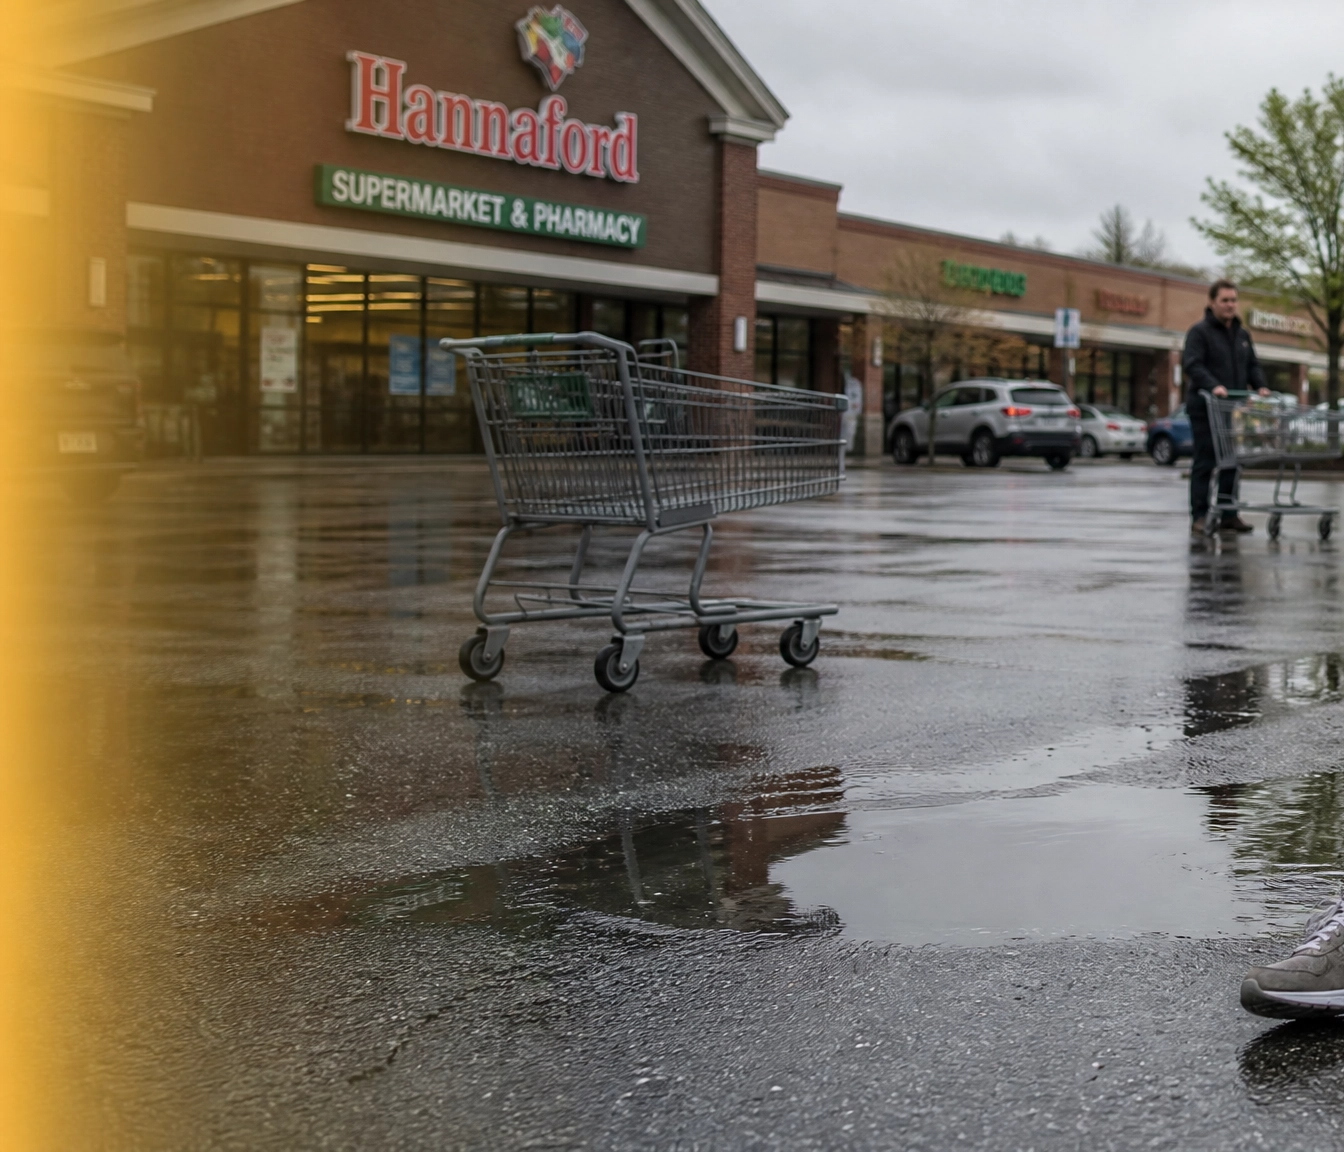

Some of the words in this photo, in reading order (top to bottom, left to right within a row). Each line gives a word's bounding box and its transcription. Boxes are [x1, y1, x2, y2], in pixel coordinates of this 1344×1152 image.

[347, 51, 638, 182] Hannaford
[332, 170, 505, 225] SUPERMARKET
[510, 199, 529, 228] &
[534, 202, 642, 244] PHARMACY
